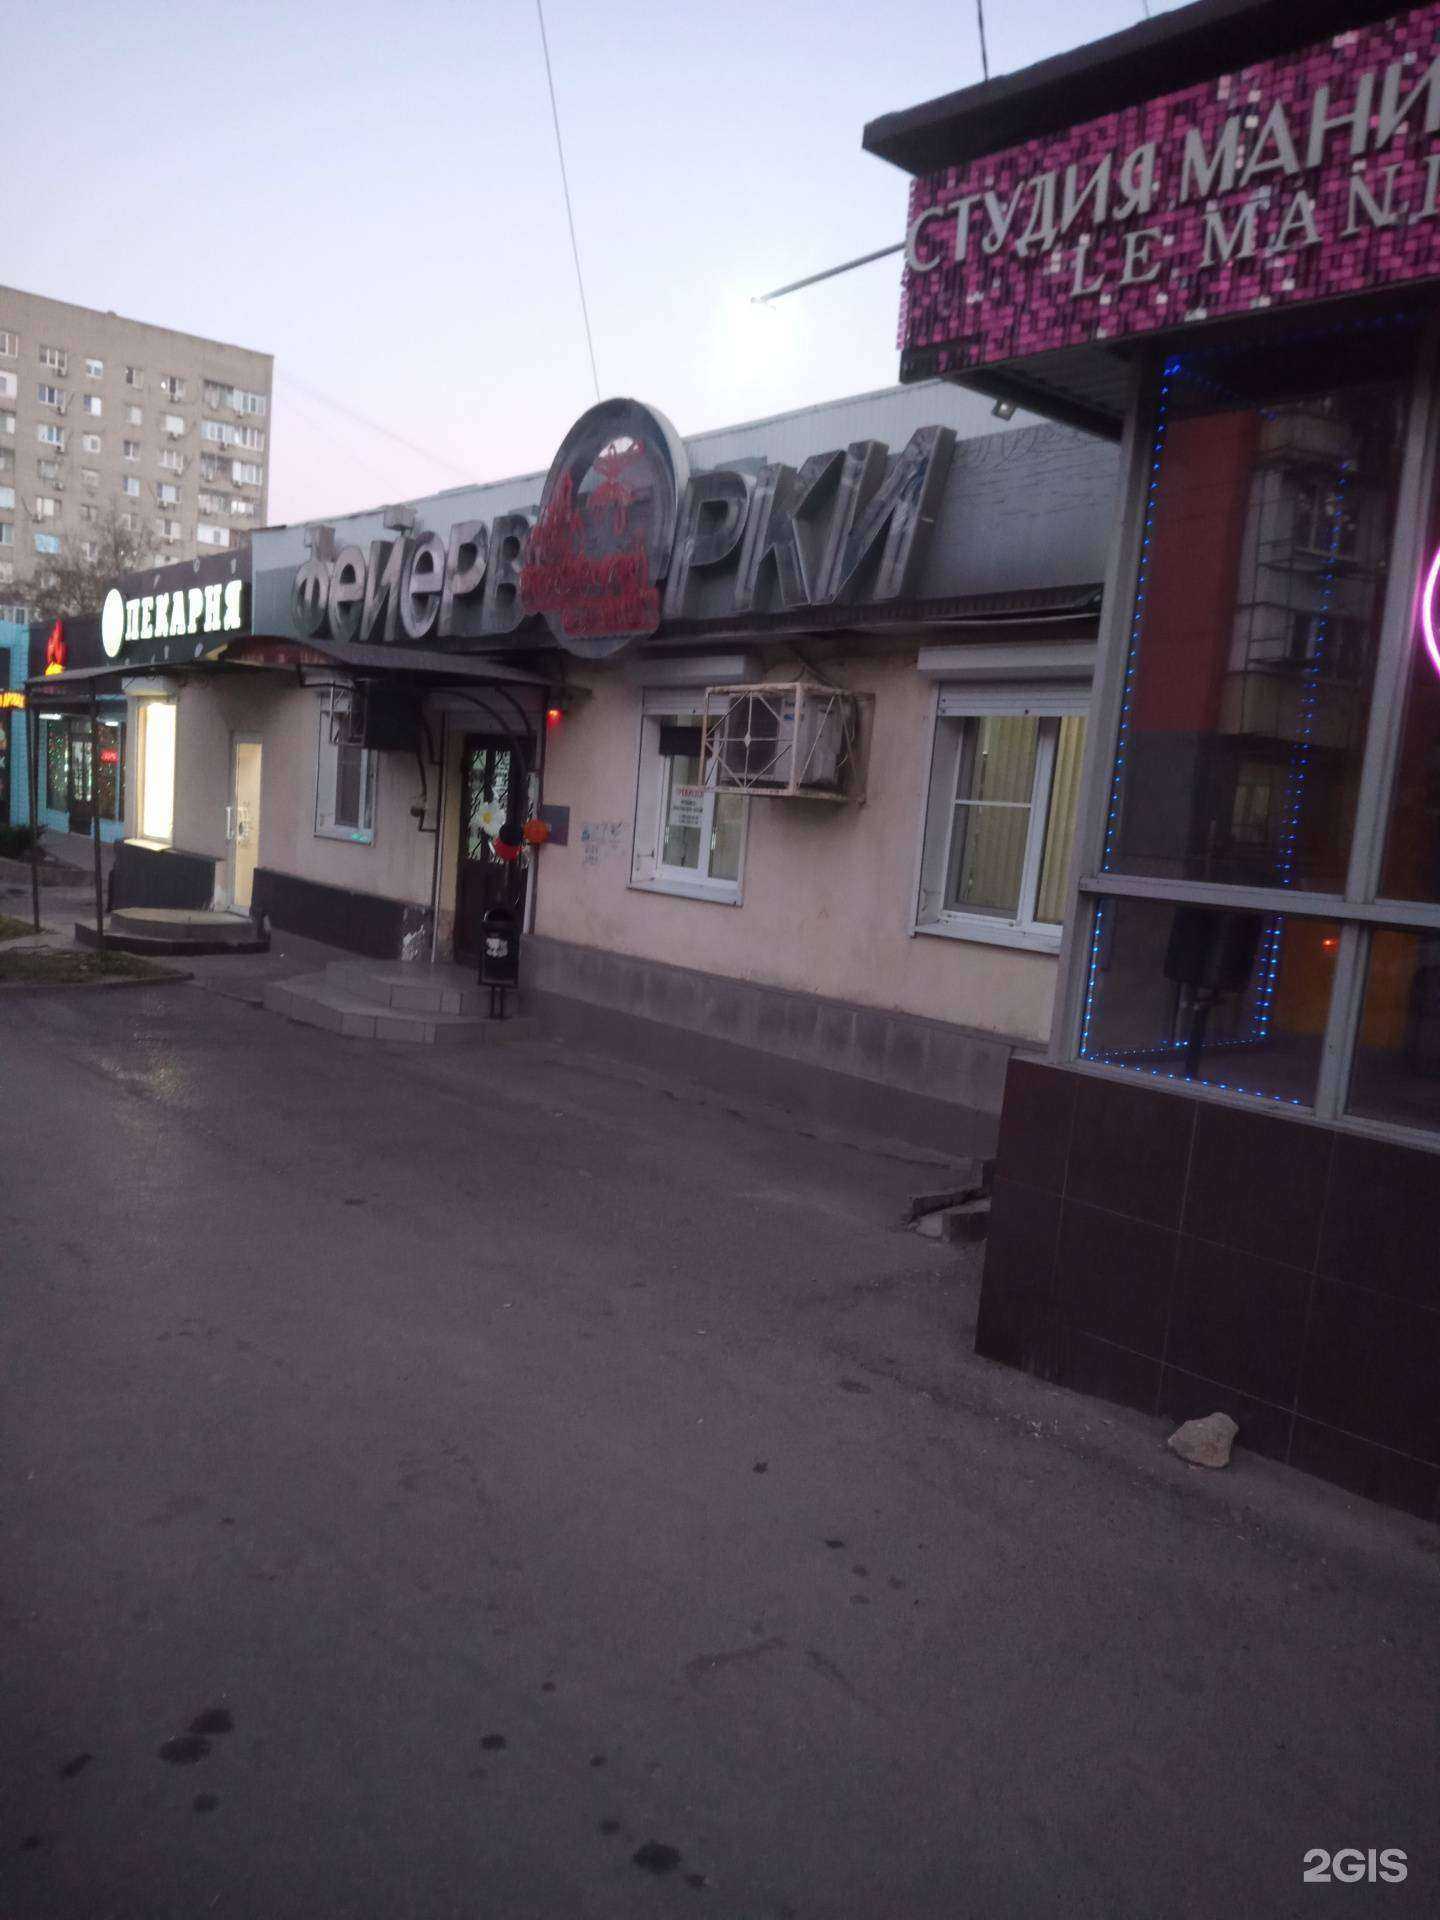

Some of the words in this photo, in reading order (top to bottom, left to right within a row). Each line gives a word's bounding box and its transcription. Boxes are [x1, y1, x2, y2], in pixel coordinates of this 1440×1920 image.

[906, 142, 1157, 272] СТУДИЯ
[1071, 228, 1164, 298] LE
[125, 579, 243, 641] ПЕКАРНЯ
